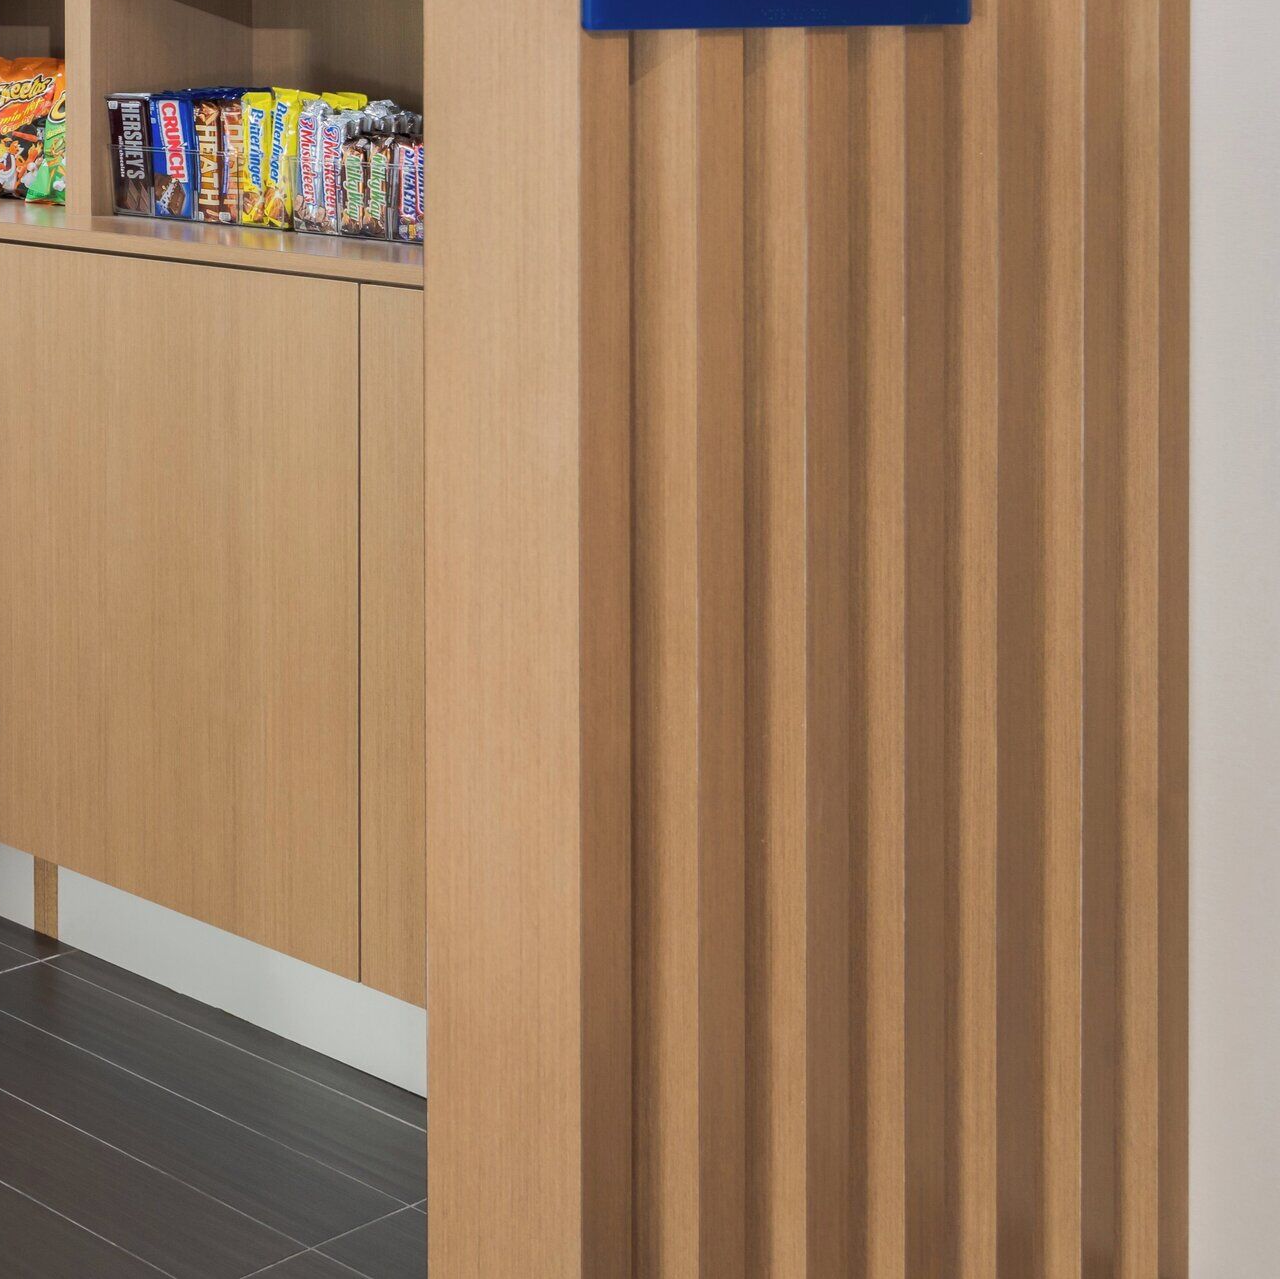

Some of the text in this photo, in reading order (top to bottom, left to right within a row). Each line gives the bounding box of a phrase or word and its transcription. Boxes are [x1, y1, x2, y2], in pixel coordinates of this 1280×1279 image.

[121, 102, 145, 180] HERSHEY'S
[161, 102, 186, 180] CRUNCH
[195, 124, 220, 206] HEATH
[248, 108, 264, 188] Butterfinger
[269, 102, 287, 184] Butterfinger
[300, 117, 318, 204] 3 Musketeers
[323, 127, 340, 217] 3 Musketeers
[343, 155, 364, 220] Milky Way
[367, 153, 387, 220] Milky Way
[402, 148, 416, 218] SNICKERS
